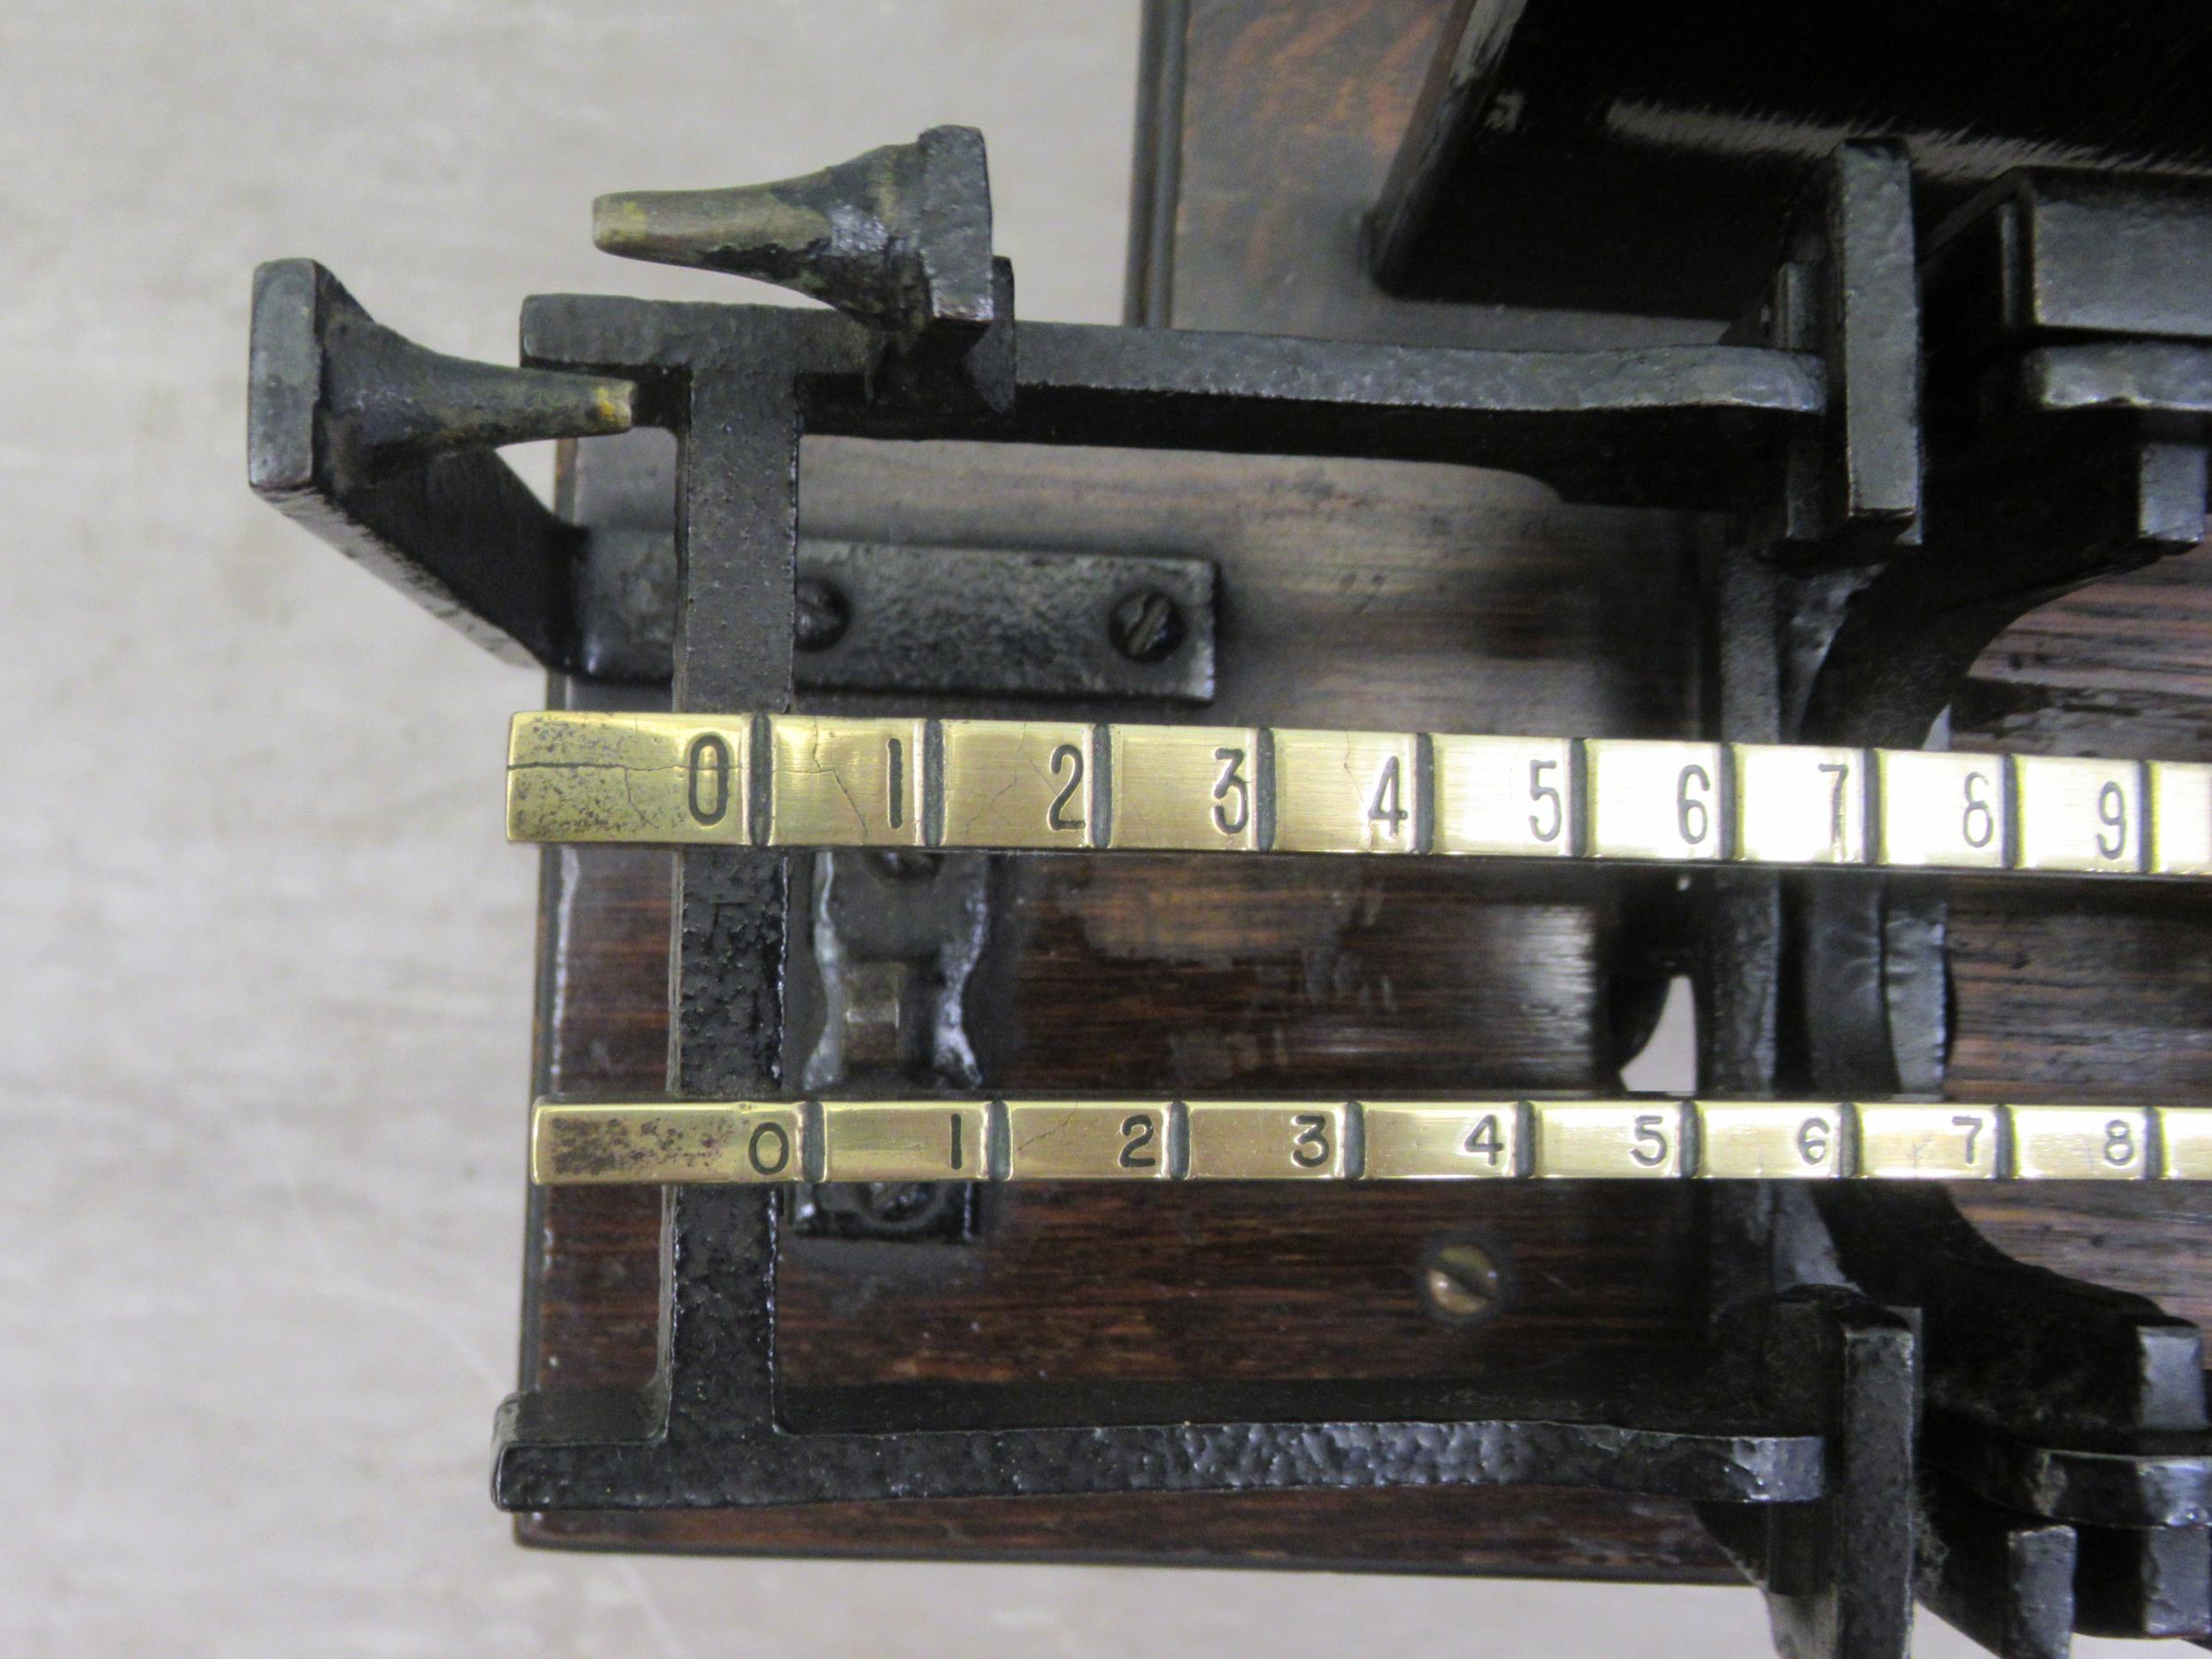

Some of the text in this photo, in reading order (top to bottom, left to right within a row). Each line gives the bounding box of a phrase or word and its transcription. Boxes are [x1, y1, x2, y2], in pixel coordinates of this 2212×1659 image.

[688, 732, 2125, 860] 0 1 2 3 4 5 6 7 8 9
[749, 1113, 2135, 1176] 0 1 2 3 4 5 6 7 8
